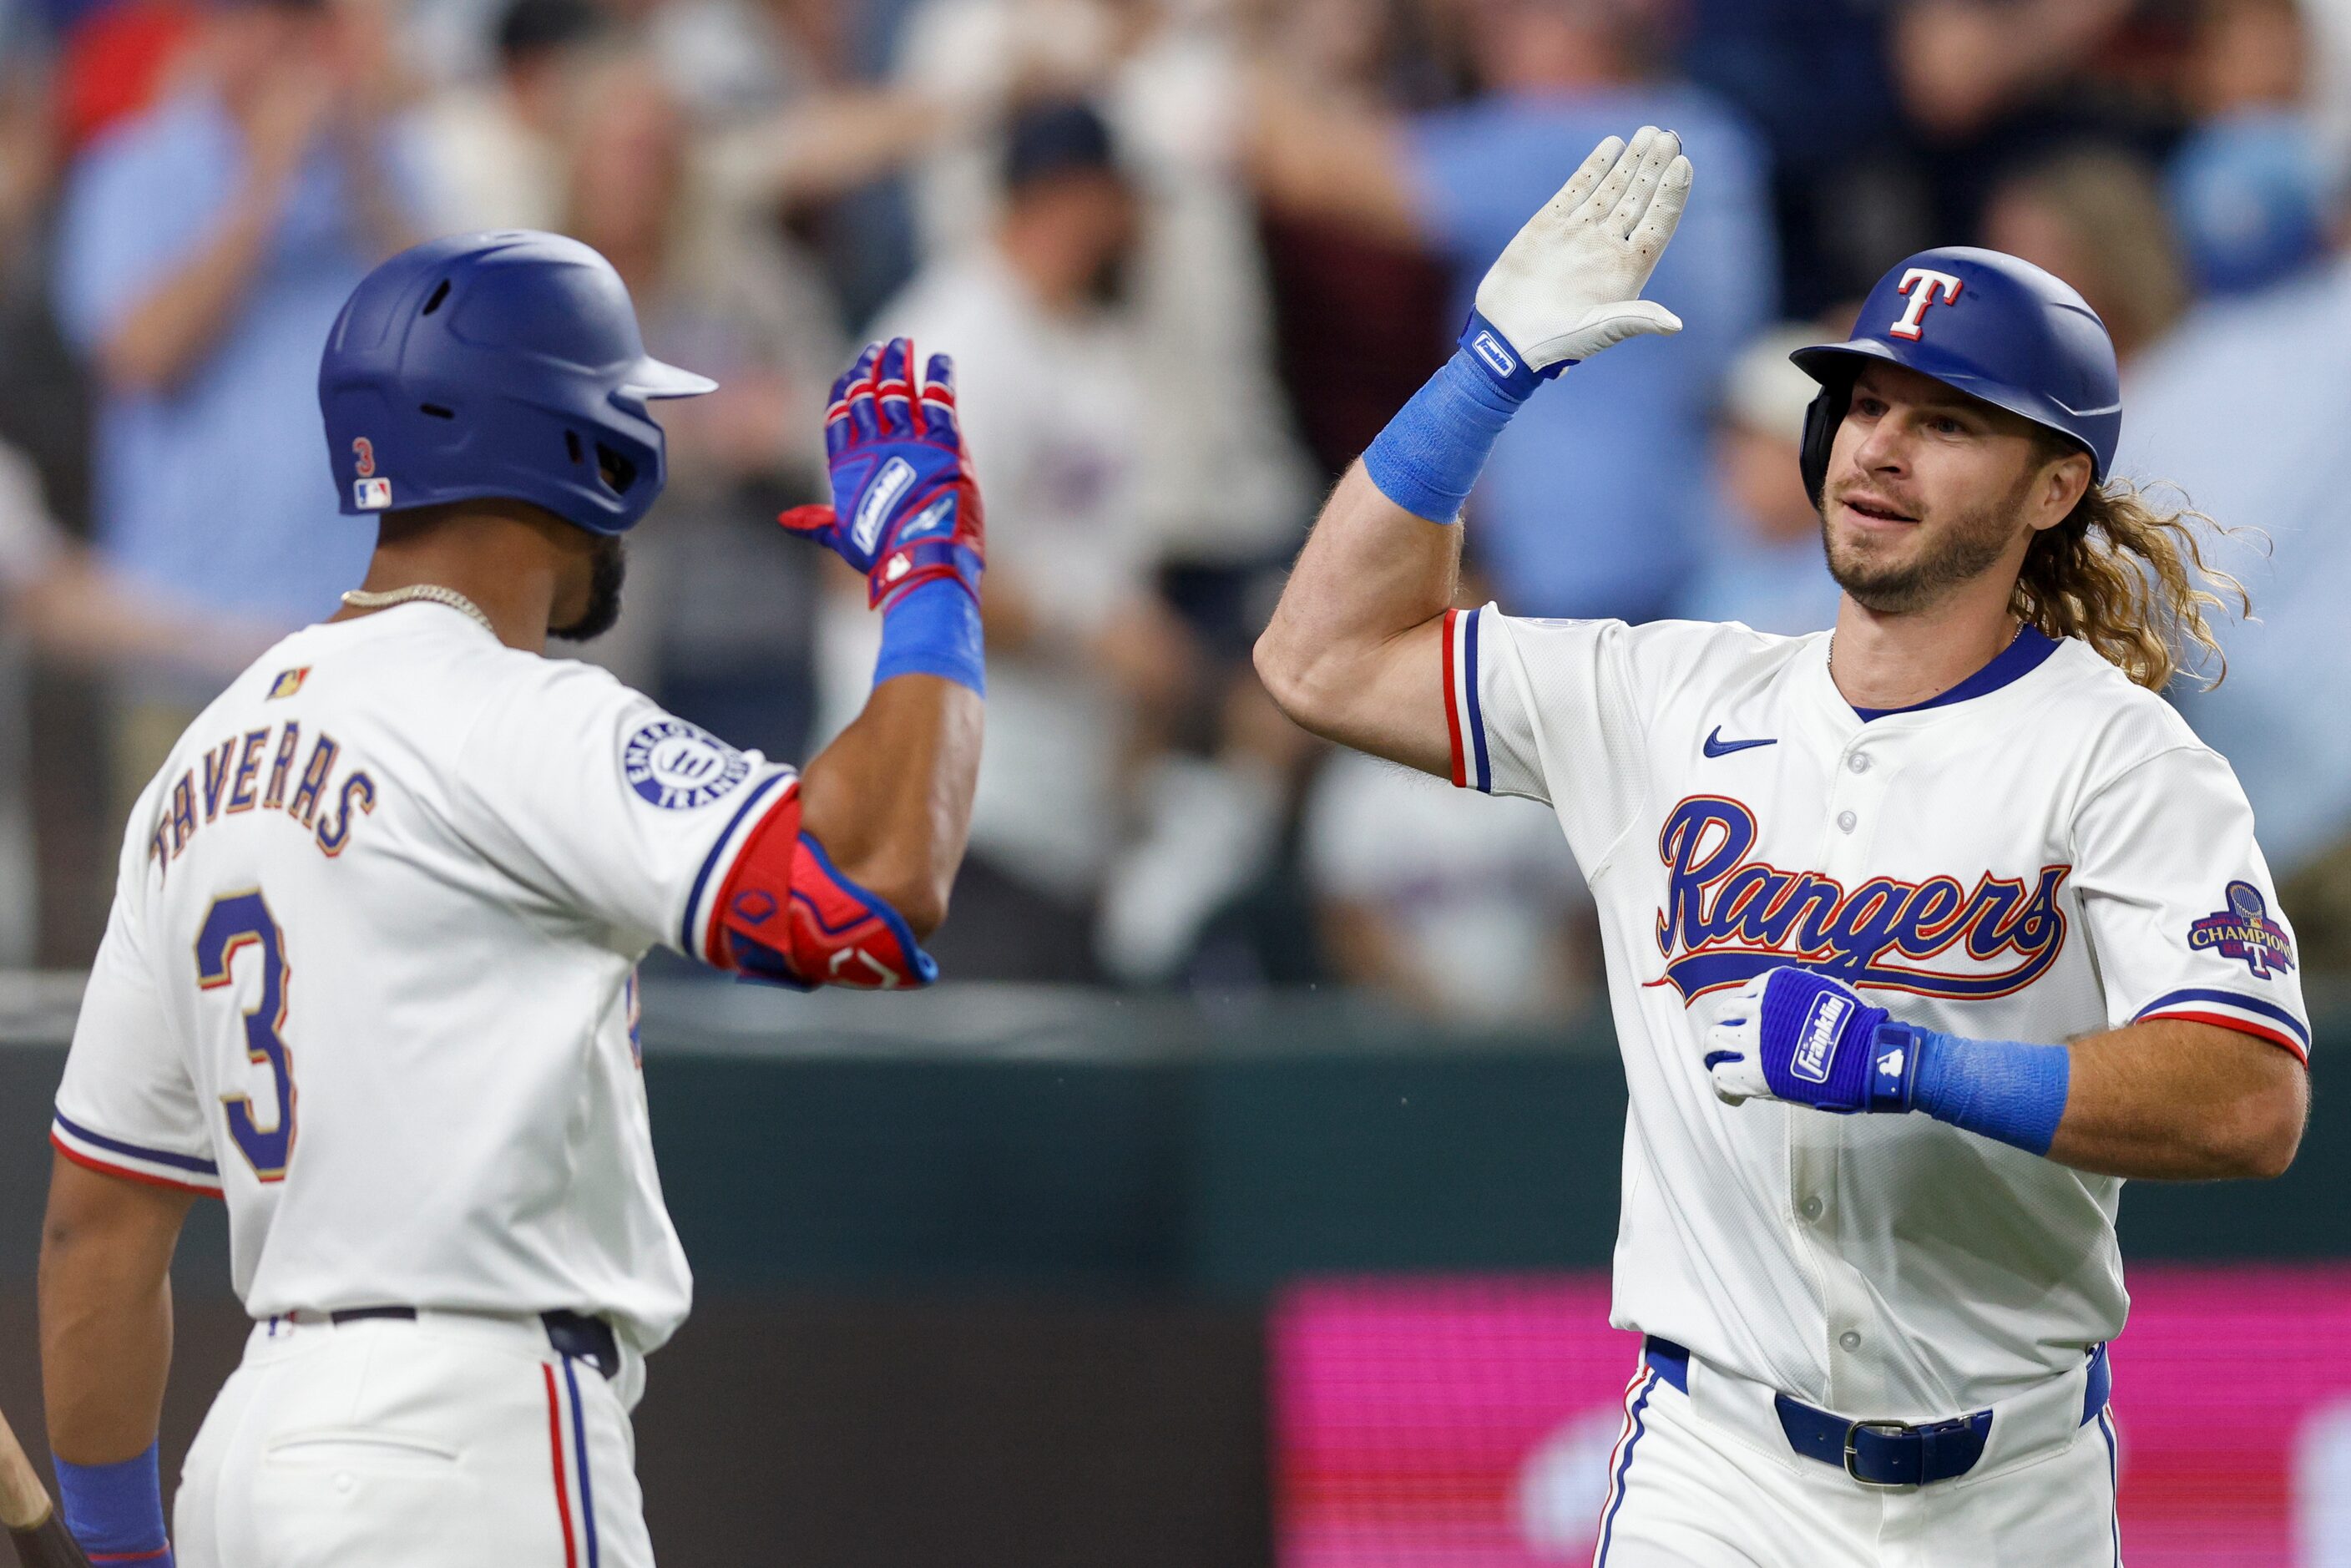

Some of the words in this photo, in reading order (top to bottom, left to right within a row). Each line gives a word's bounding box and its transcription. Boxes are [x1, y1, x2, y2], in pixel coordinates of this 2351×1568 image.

[1889, 268, 1964, 342] T
[1476, 337, 1509, 371] Franklin
[352, 437, 376, 478] 3
[149, 720, 377, 893] TAVERAS
[656, 751, 751, 810] TRANS
[1641, 794, 2072, 1010] Rangers
[2192, 926, 2294, 966] CHAMPIONS
[193, 885, 297, 1184] 3
[1797, 995, 1846, 1079] Franklin
